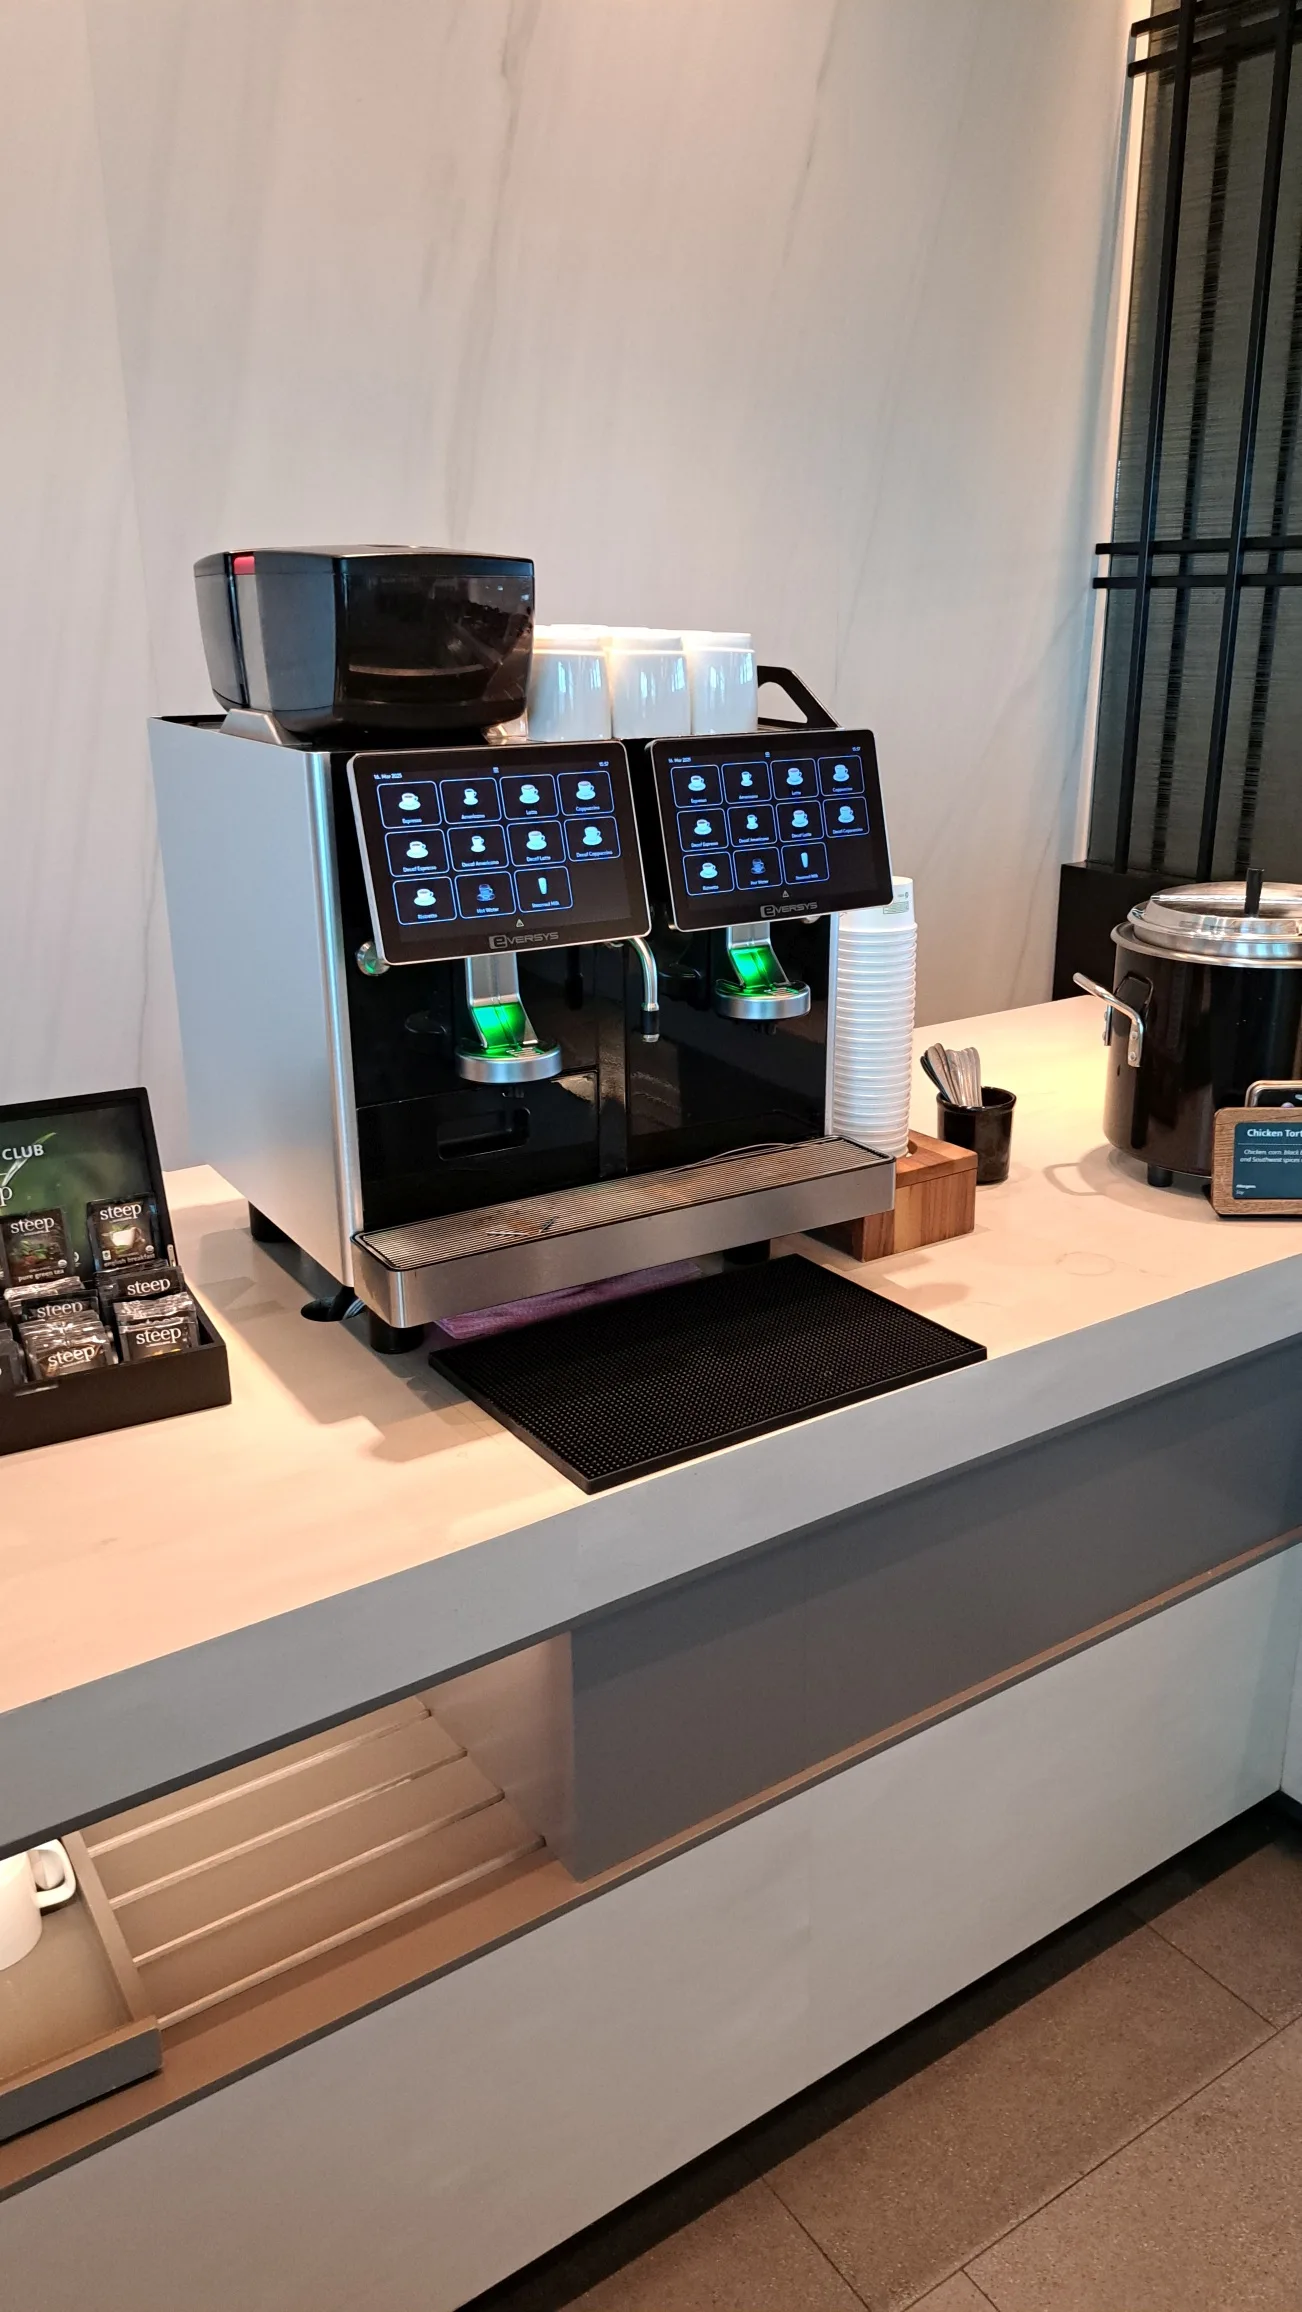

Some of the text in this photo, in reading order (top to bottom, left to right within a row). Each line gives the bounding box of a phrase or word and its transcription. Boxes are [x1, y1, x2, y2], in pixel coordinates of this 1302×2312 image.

[1247, 1129, 1283, 1137] Chicken
[2, 1144, 45, 1160] CLUB
[100, 1203, 142, 1220] steep
[10, 1217, 55, 1234] steep
[127, 1278, 171, 1296] steep
[37, 1301, 83, 1319] steep
[136, 1327, 182, 1345] steep
[48, 1346, 95, 1367] steep
